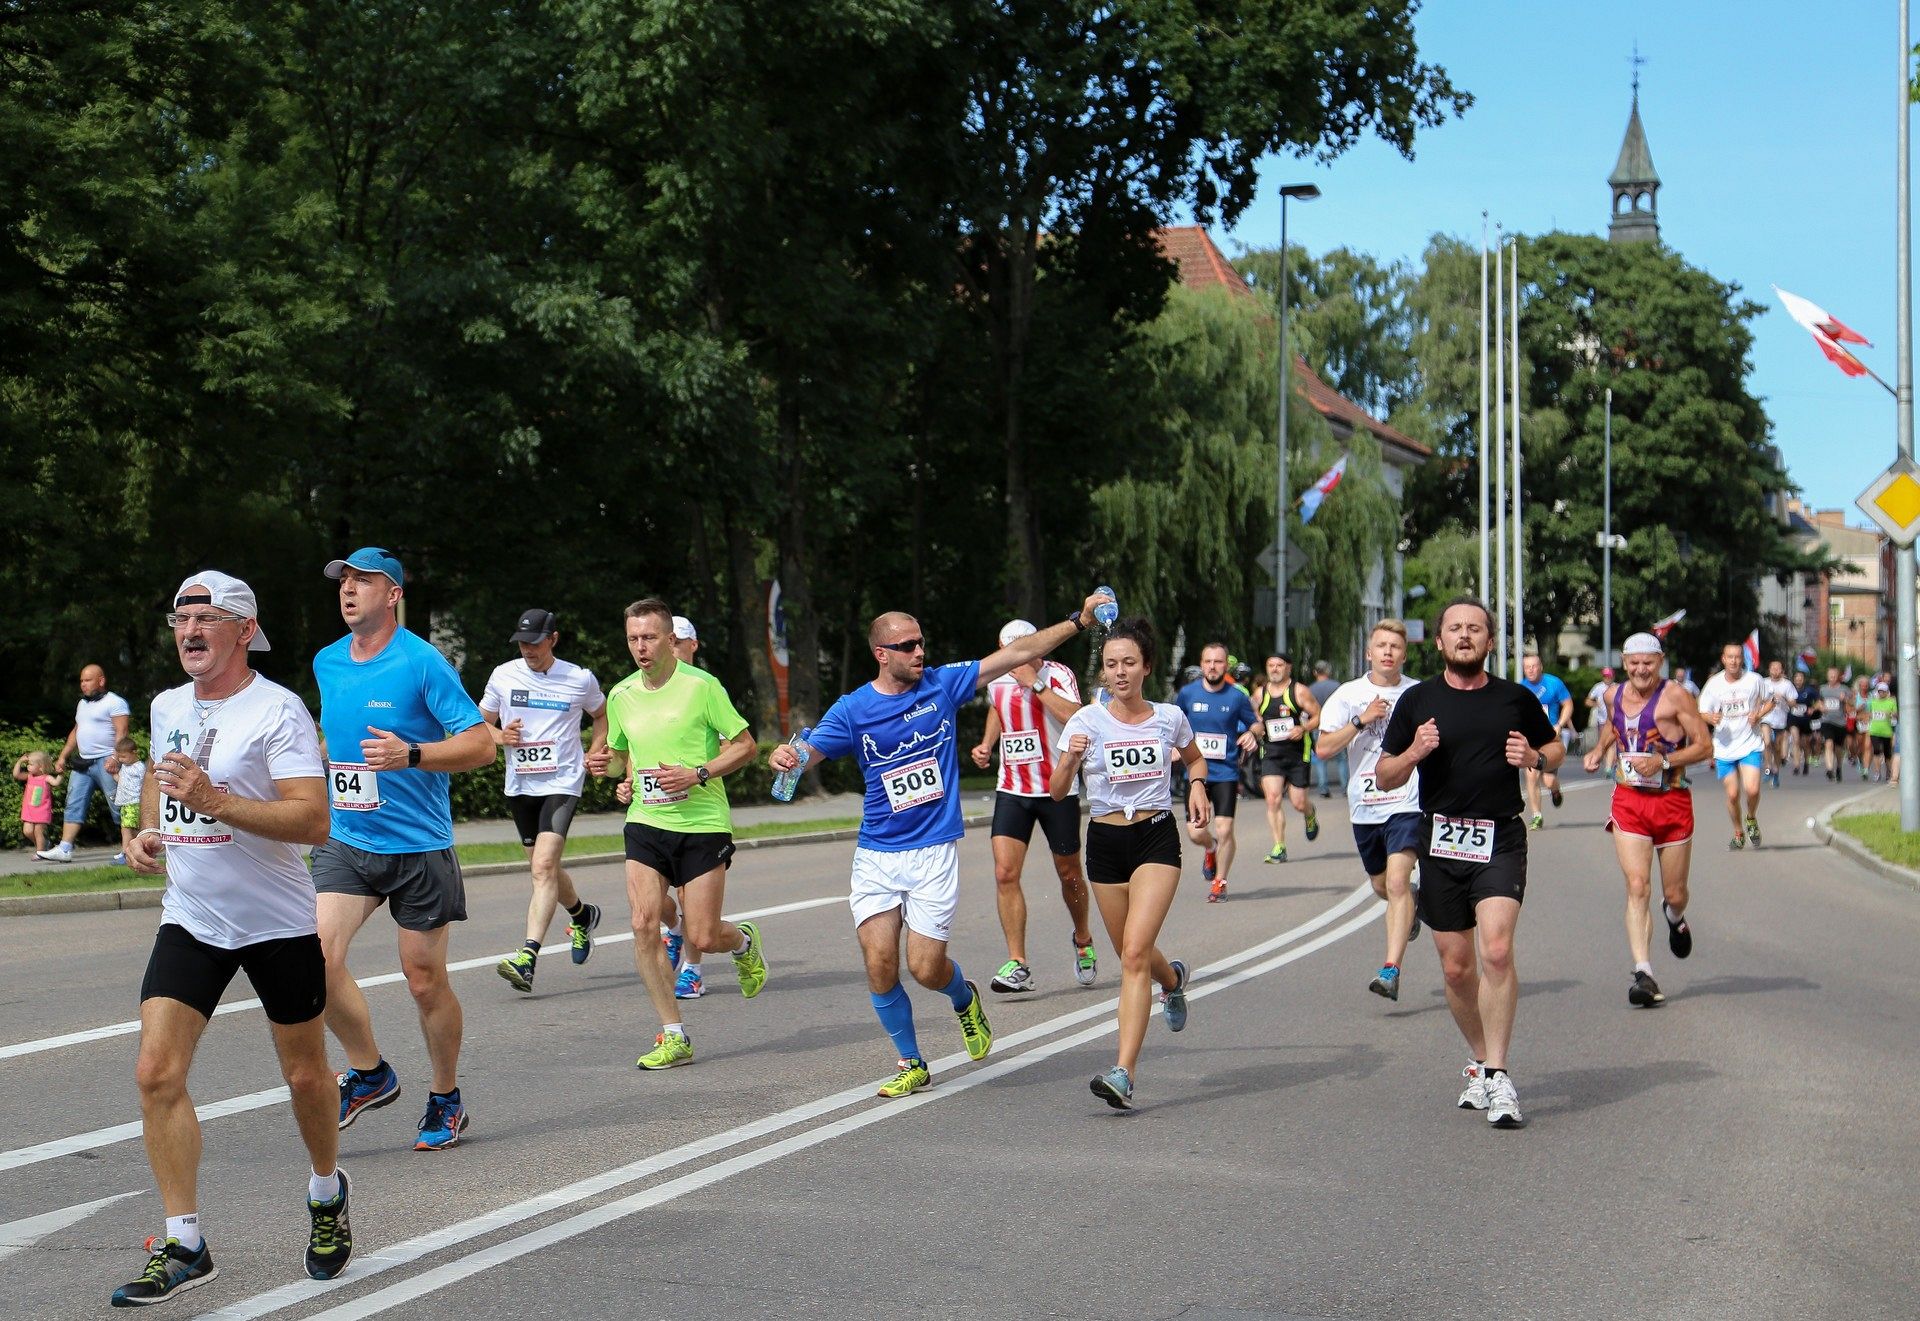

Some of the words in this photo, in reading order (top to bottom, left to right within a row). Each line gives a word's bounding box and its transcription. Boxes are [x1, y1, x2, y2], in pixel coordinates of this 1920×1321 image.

[1005, 738, 1035, 753] 528
[1203, 739, 1218, 750] 30
[516, 747, 551, 762] 382
[1111, 747, 1156, 768] 503
[335, 772, 361, 794] 64
[892, 768, 936, 796] 508
[1151, 811, 1167, 824] NIKE
[1439, 823, 1486, 847] 275
